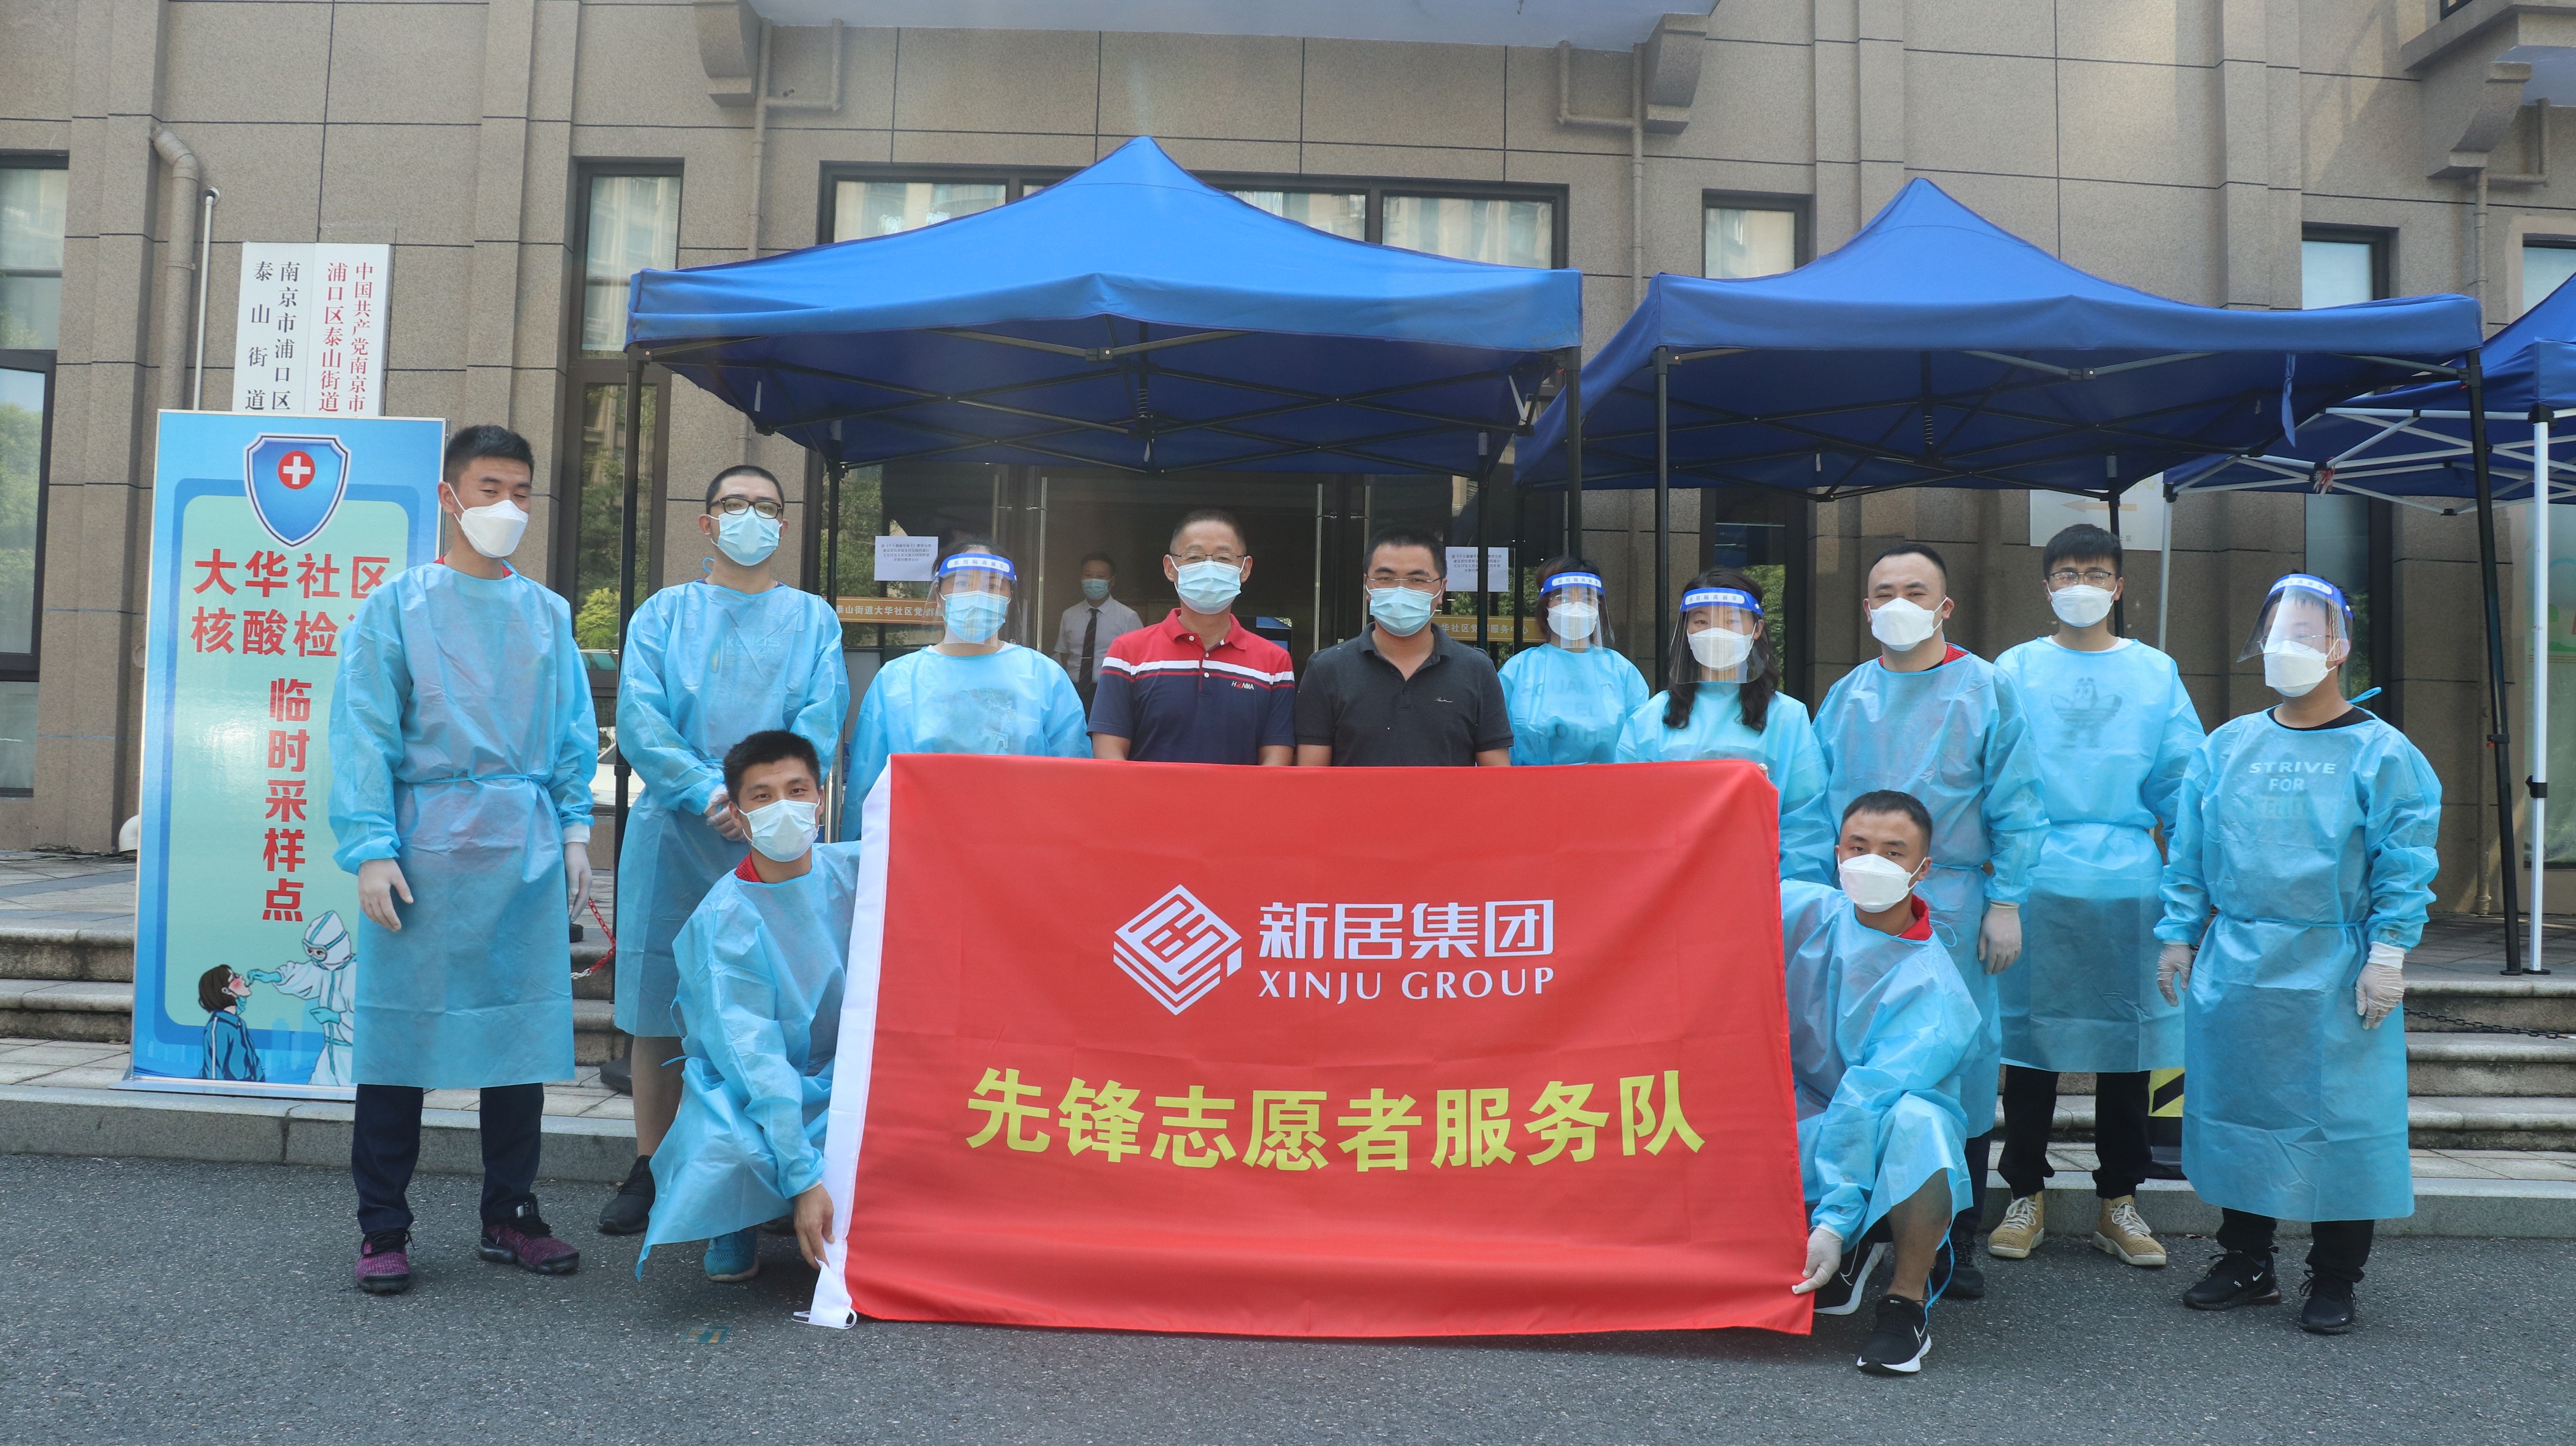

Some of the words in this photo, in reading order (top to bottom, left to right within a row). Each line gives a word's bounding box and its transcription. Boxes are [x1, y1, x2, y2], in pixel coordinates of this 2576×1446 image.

[245, 261, 273, 410] 泰山街道
[272, 261, 301, 410] 南京市浦口区
[319, 262, 349, 412] 浦口区泰山街道
[348, 262, 374, 413] 中国共产党南京市
[193, 549, 390, 599] 大华社区
[191, 606, 355, 657] 核酸检
[262, 677, 312, 922] 临时采样点
[2248, 761, 2336, 775] STRIVE
[2269, 778, 2305, 792] FOR
[1258, 899, 1554, 960] 新居集团
[1258, 969, 1382, 1005] XINJU
[1401, 966, 1554, 1000] GROUP
[966, 1067, 1705, 1172] 先锋志愿者服务队
